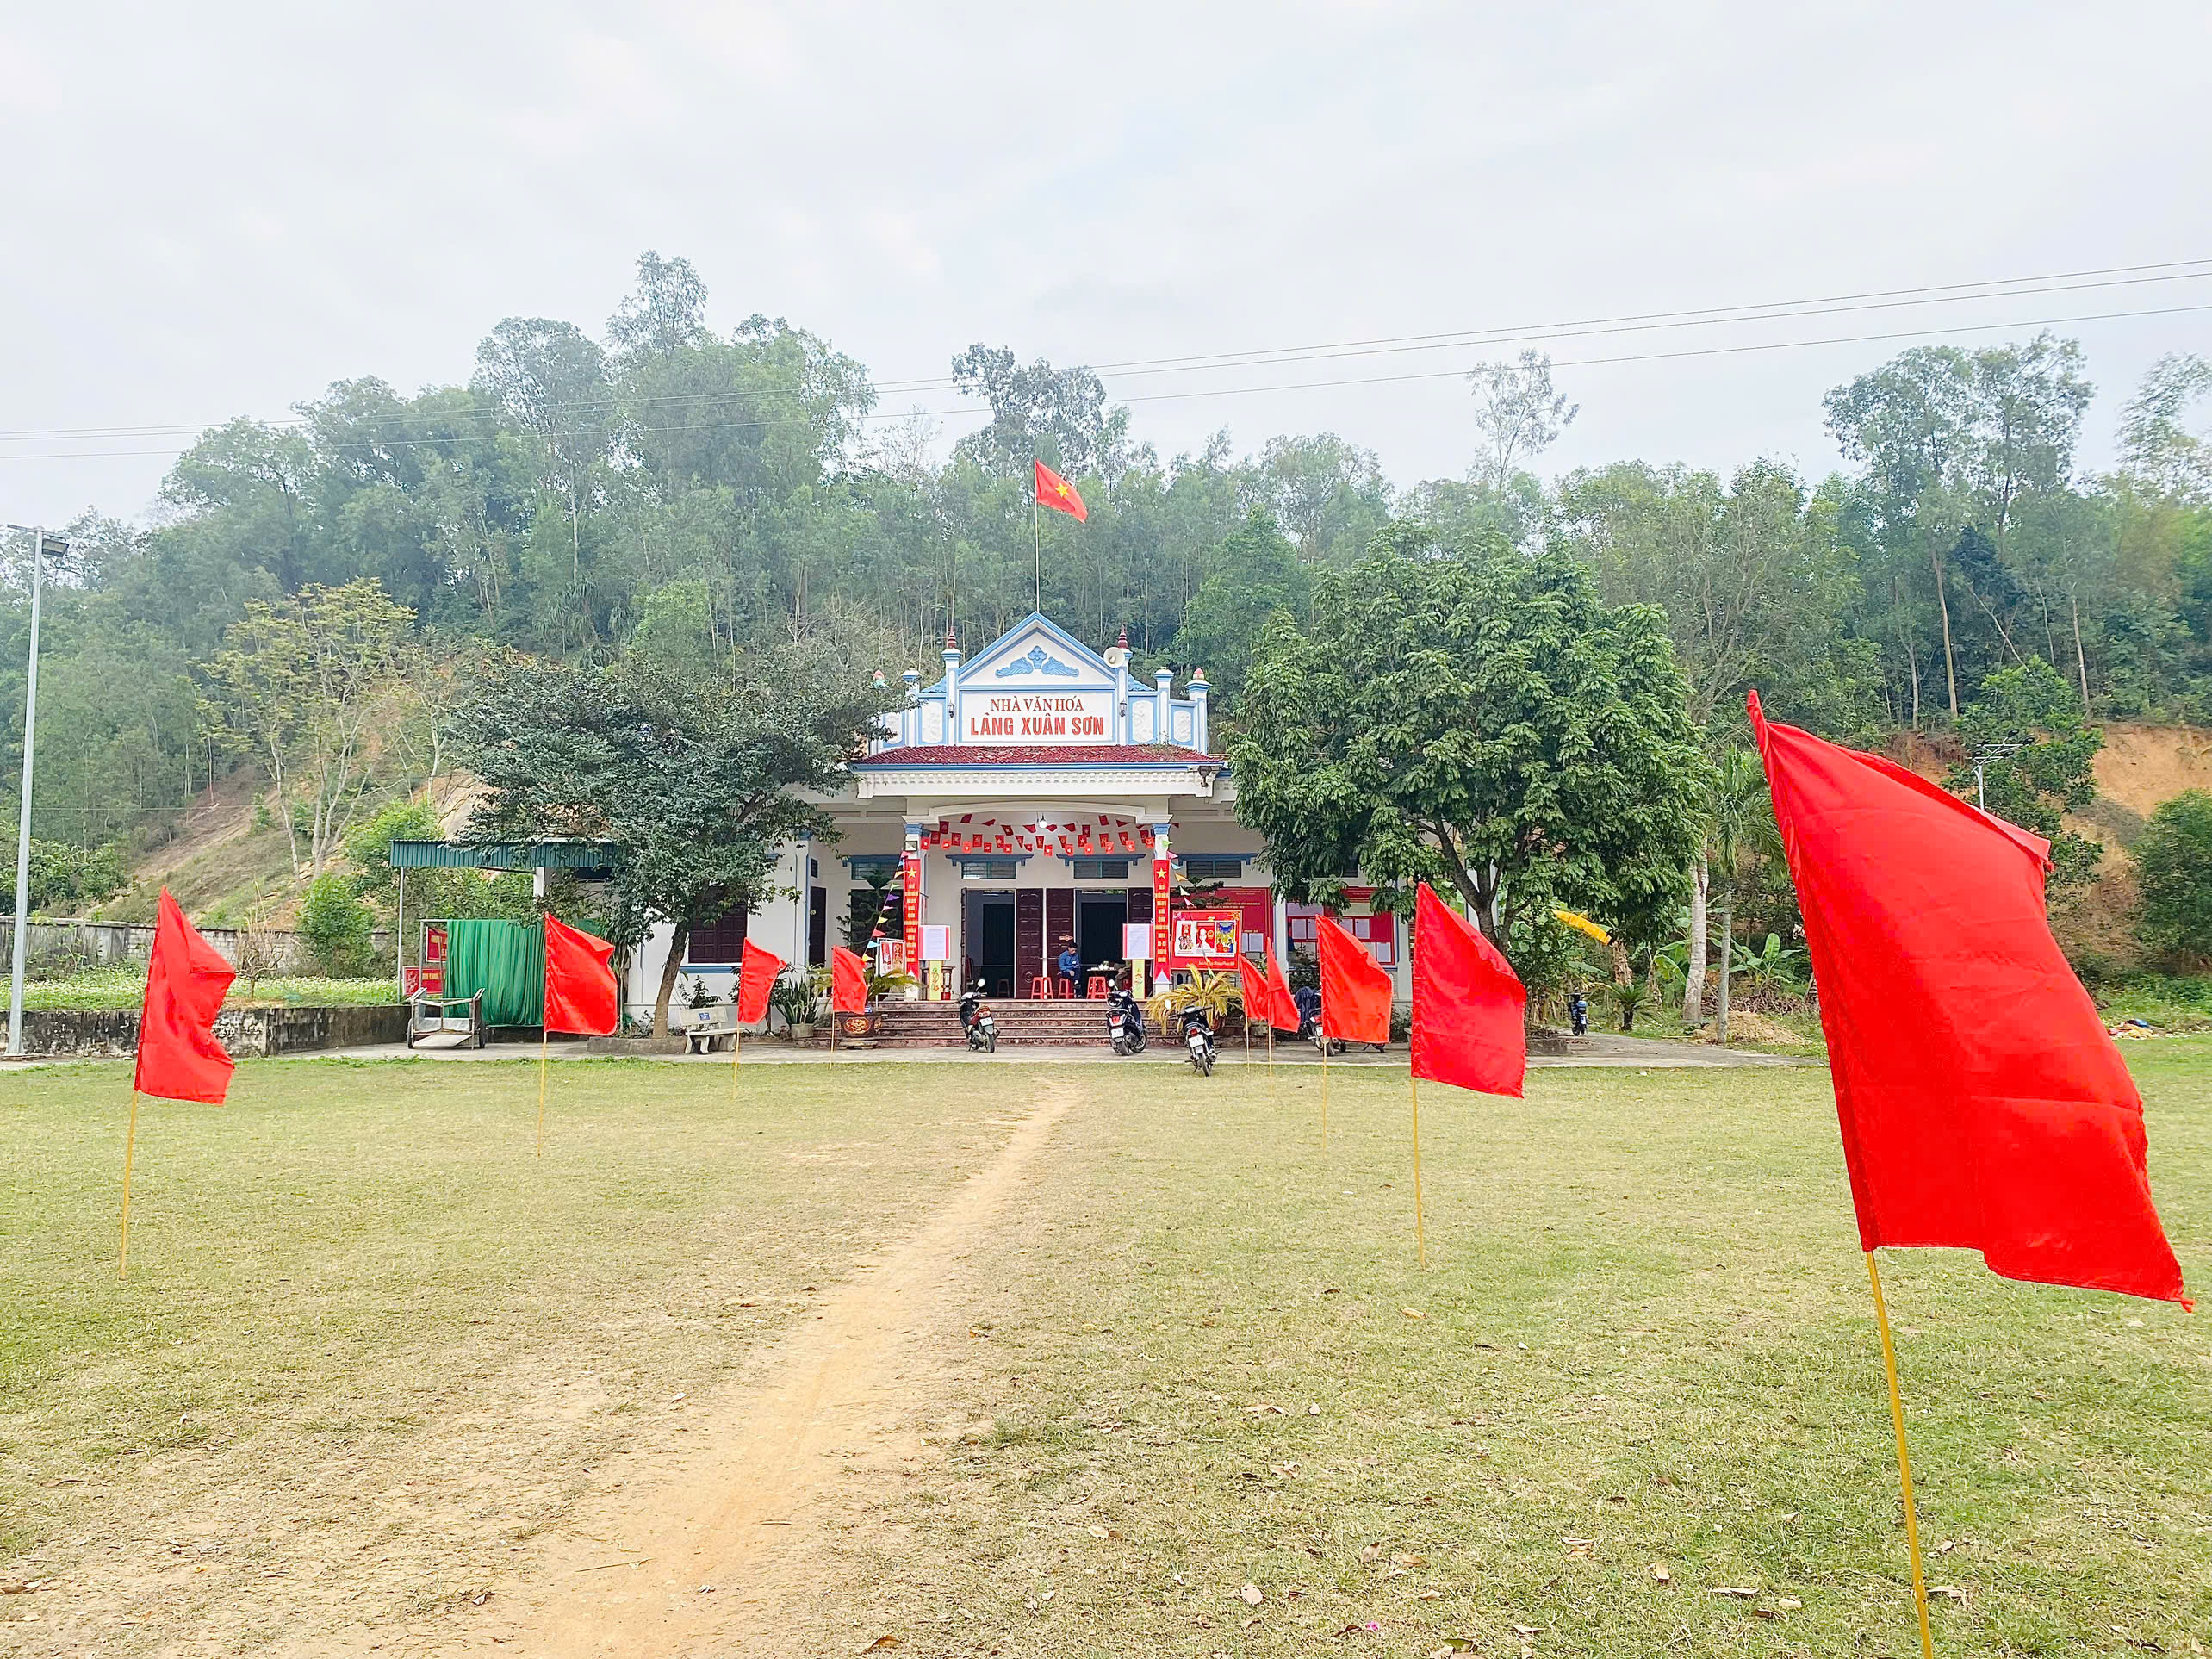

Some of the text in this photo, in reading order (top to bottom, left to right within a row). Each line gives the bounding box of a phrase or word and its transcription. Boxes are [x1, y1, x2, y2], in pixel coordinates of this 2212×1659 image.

[991, 696, 1021, 711] NHÀ
[1023, 696, 1053, 711] VĂN
[971, 712, 1104, 736] LÀNG XUÂN SƠN
